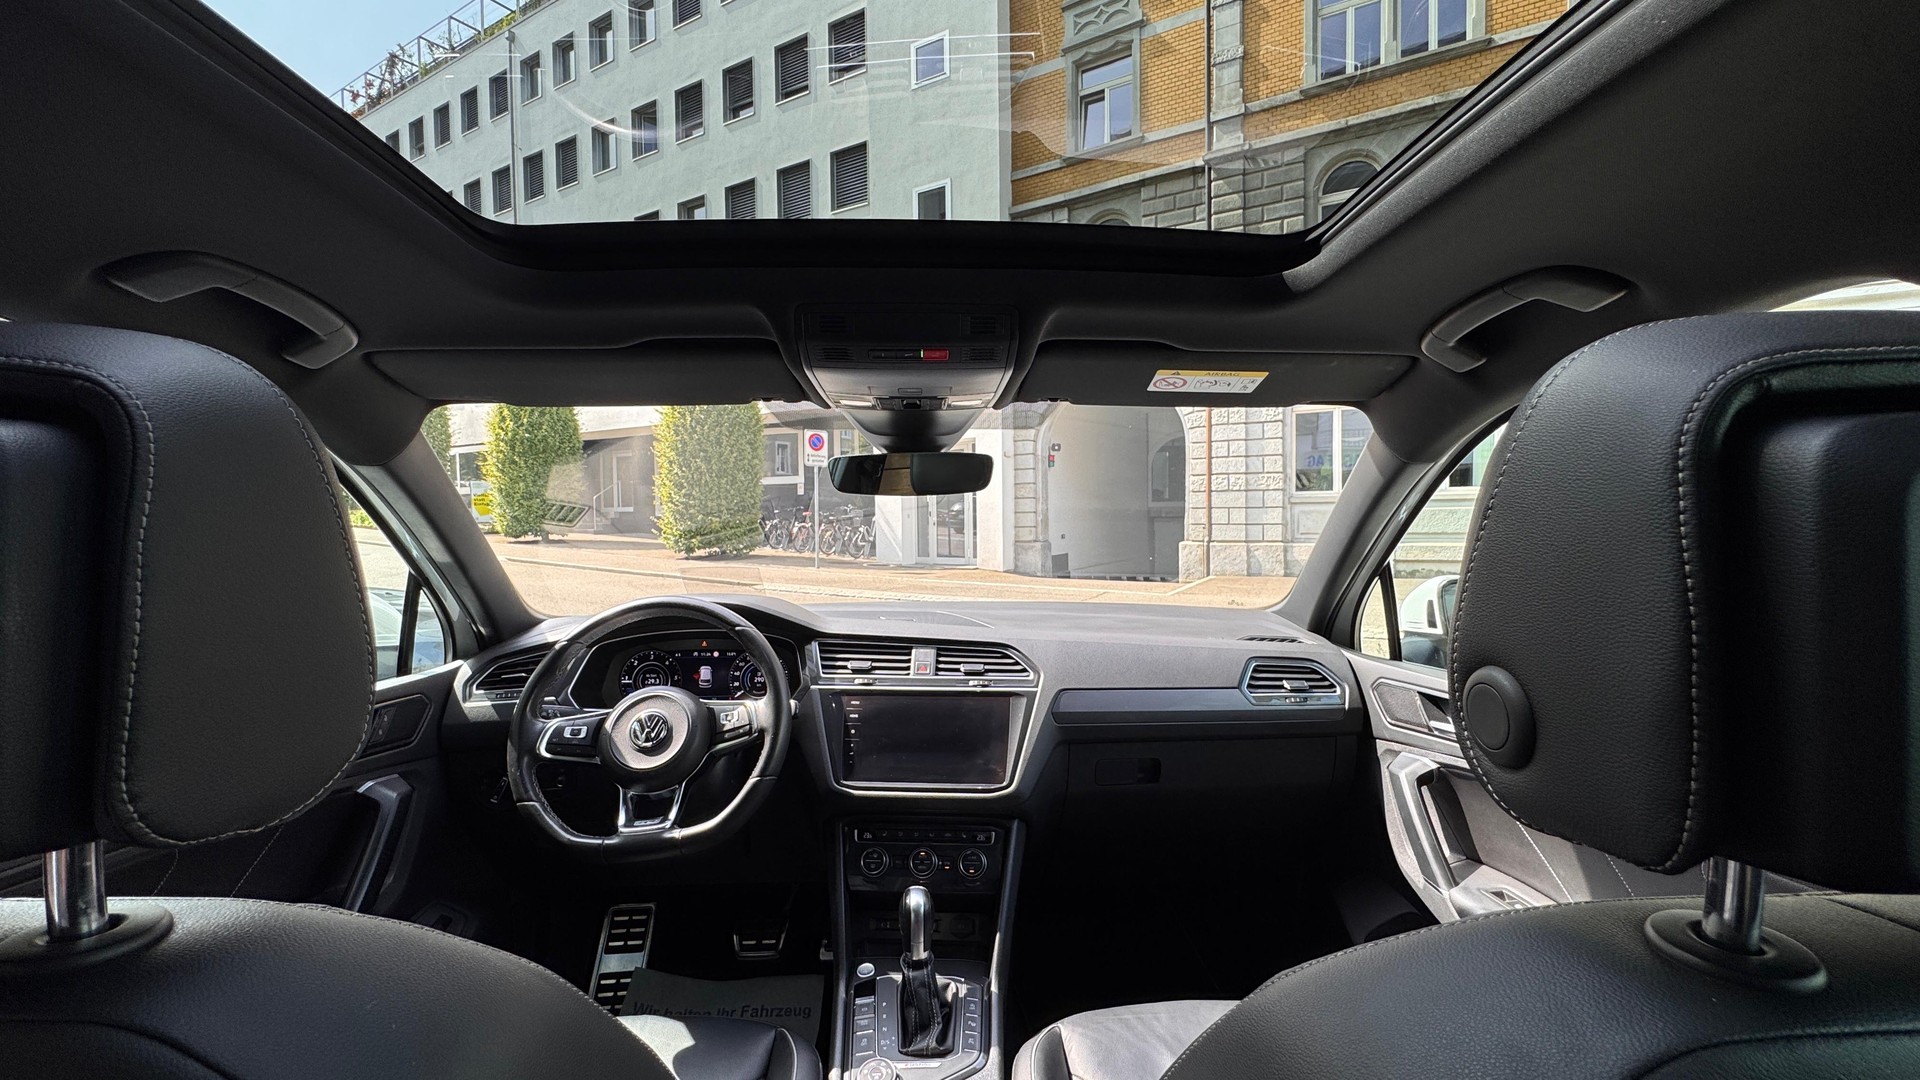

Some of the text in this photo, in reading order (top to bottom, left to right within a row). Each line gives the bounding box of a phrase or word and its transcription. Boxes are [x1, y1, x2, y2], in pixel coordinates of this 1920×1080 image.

[632, 1002, 660, 1016] Wir
[716, 1007, 736, 1018] Ihr
[740, 1004, 812, 1019] Fahrzeug
